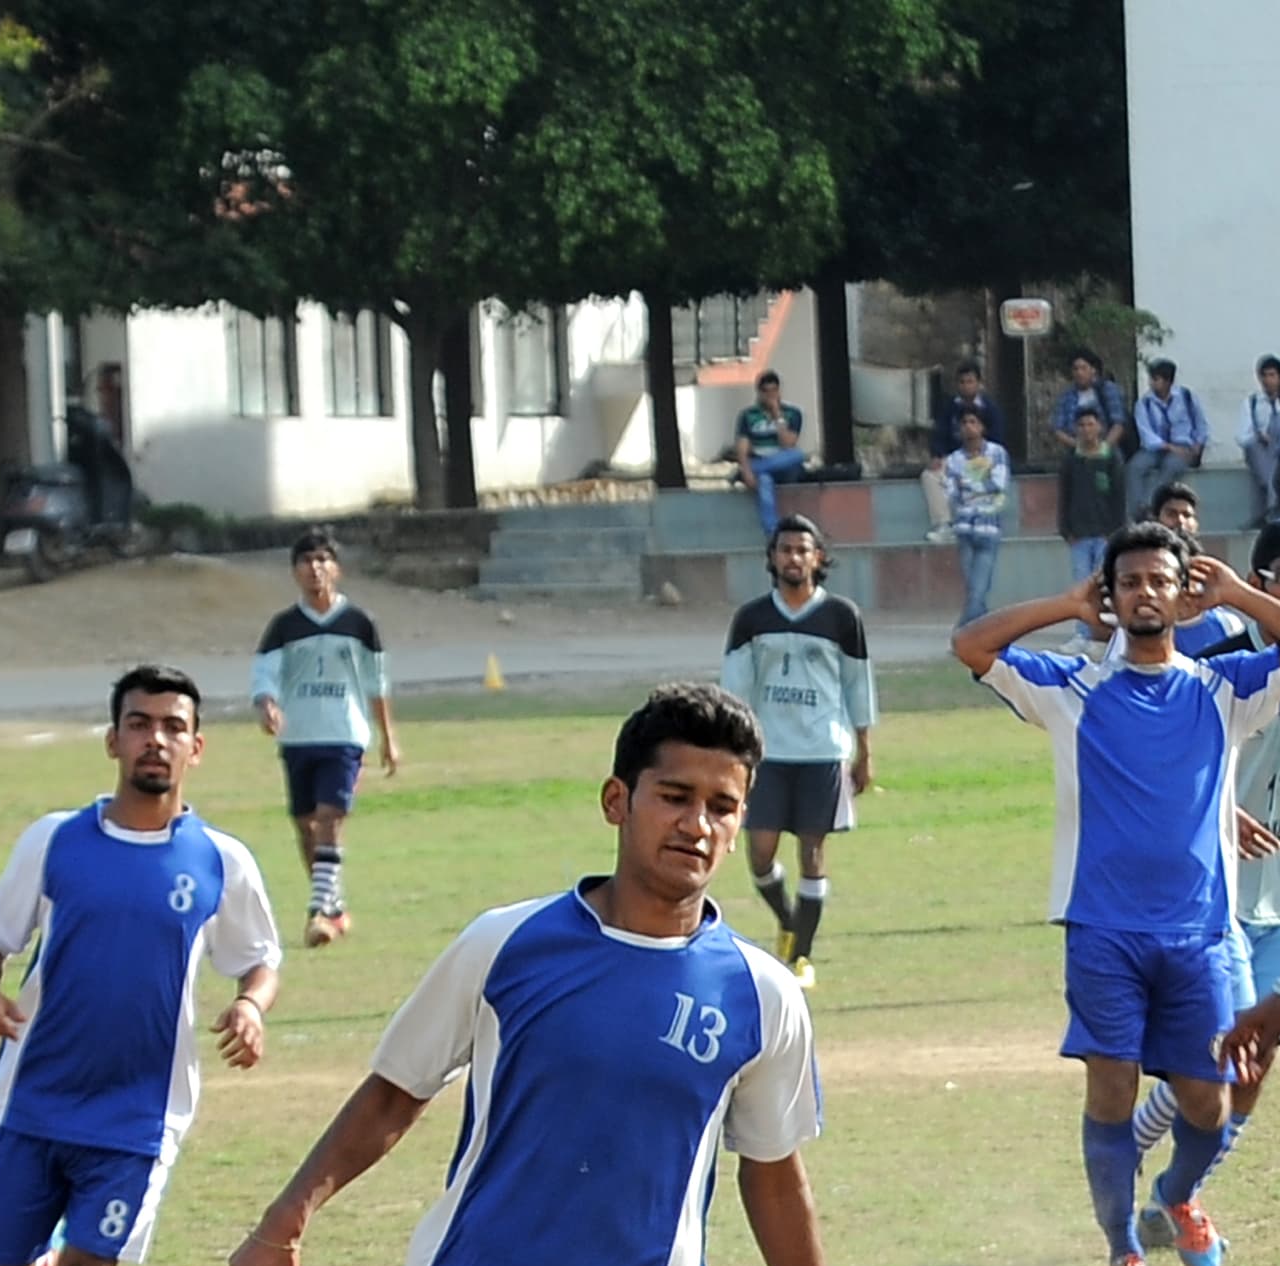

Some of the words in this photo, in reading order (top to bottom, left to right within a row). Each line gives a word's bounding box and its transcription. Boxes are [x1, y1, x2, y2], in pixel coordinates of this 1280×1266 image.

[169, 873, 195, 912] 8
[657, 991, 728, 1064] 13
[99, 1198, 128, 1239] 8
